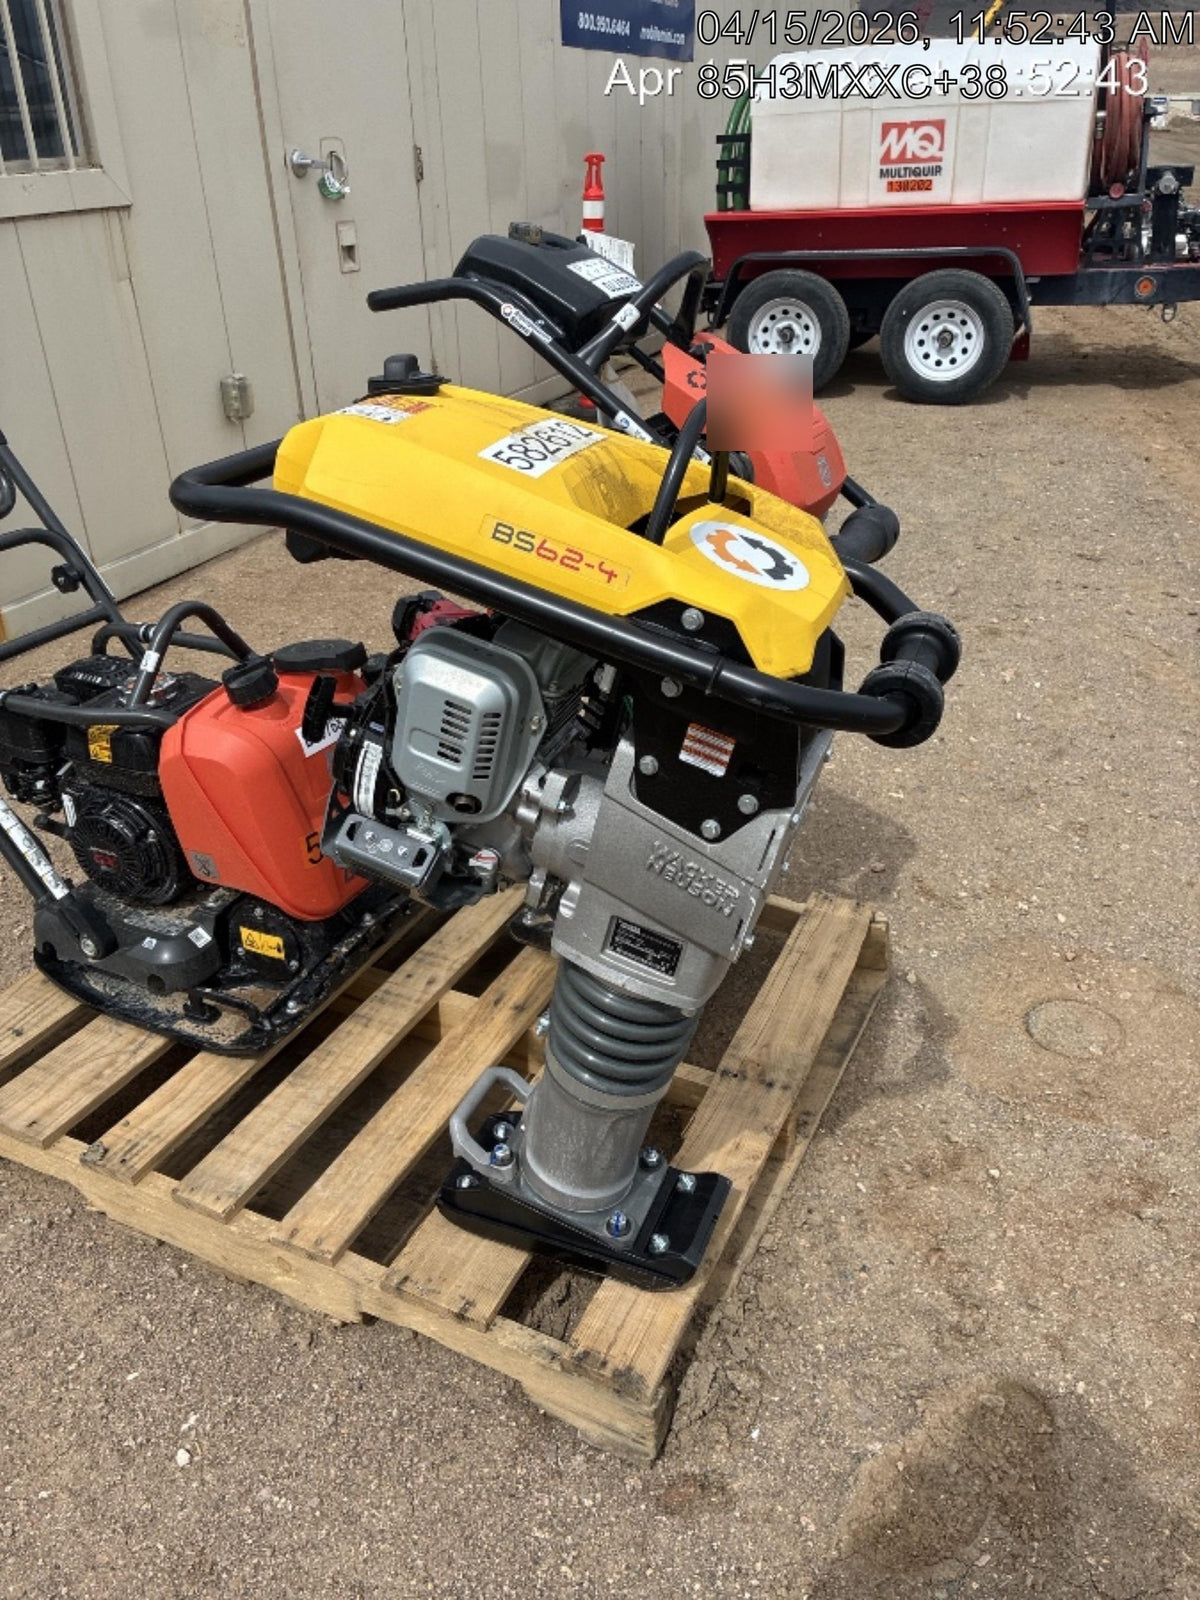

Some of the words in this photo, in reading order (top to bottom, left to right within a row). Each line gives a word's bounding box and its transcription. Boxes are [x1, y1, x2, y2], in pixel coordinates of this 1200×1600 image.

[880, 125, 942, 161] MQ
[880, 165, 942, 179] MULTIQUIP
[492, 421, 594, 470] 582612
[491, 522, 618, 584] BS62-4
